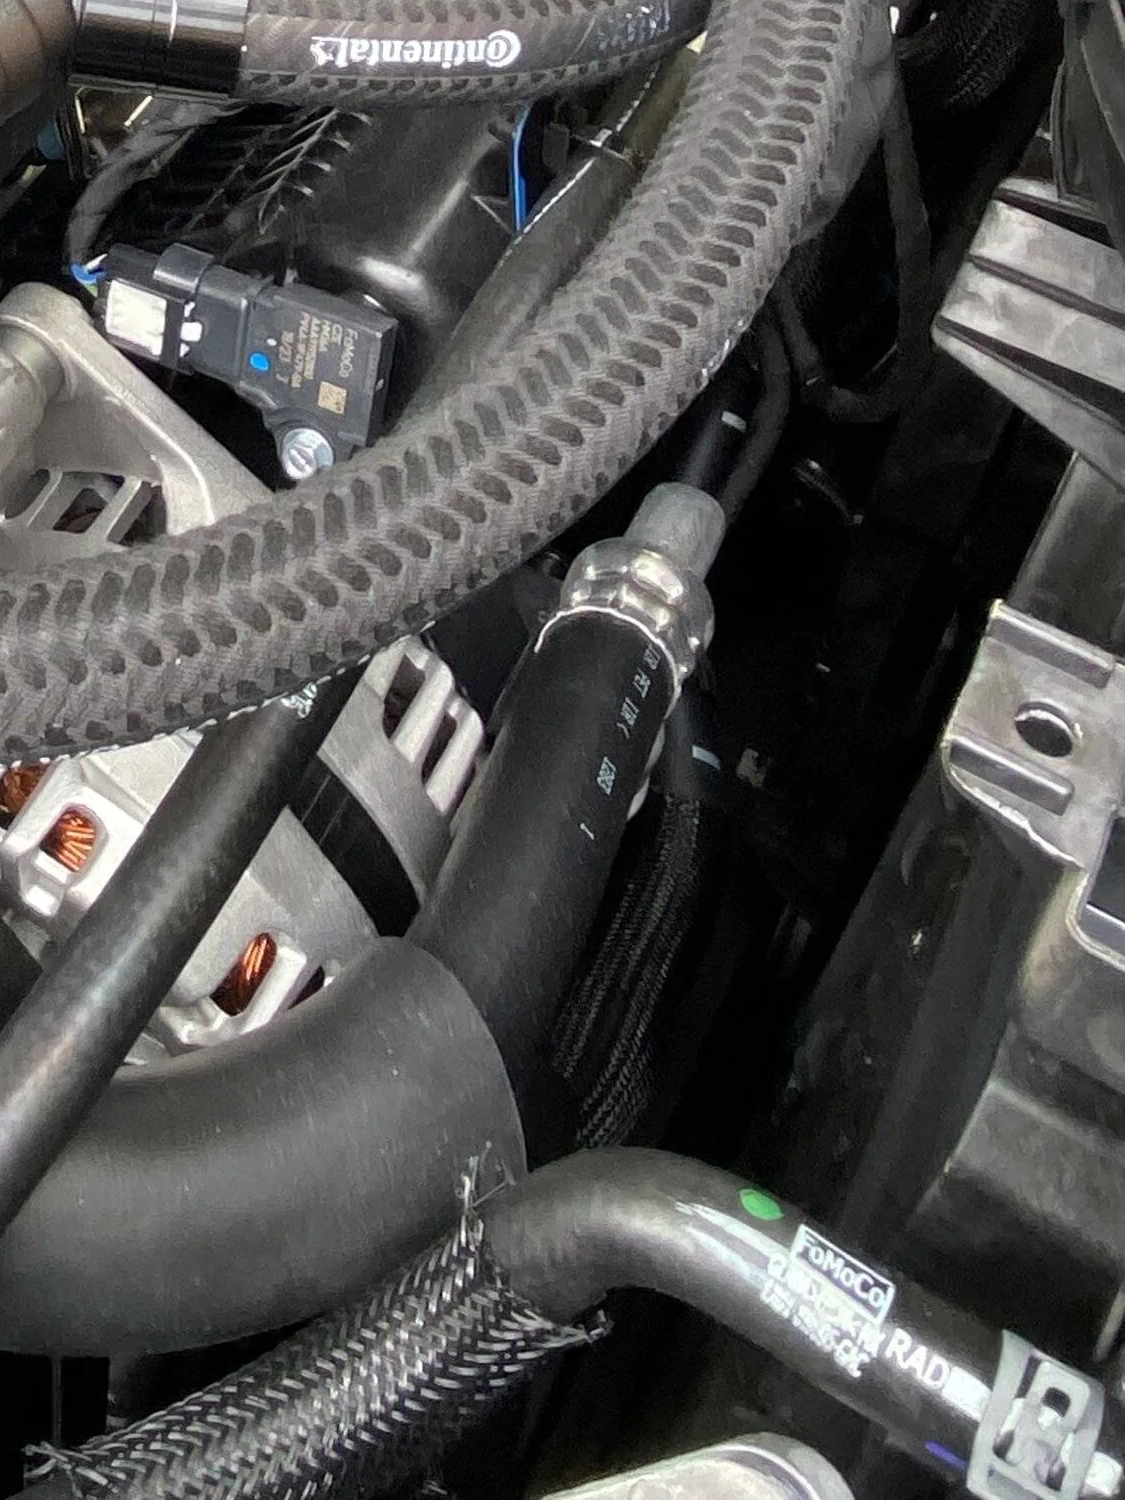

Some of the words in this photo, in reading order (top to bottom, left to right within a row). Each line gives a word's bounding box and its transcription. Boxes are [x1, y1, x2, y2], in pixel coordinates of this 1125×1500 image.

[335, 29, 521, 69] Continental
[339, 327, 358, 378] FoMoCo
[797, 1236, 887, 1309] FoMoCo
